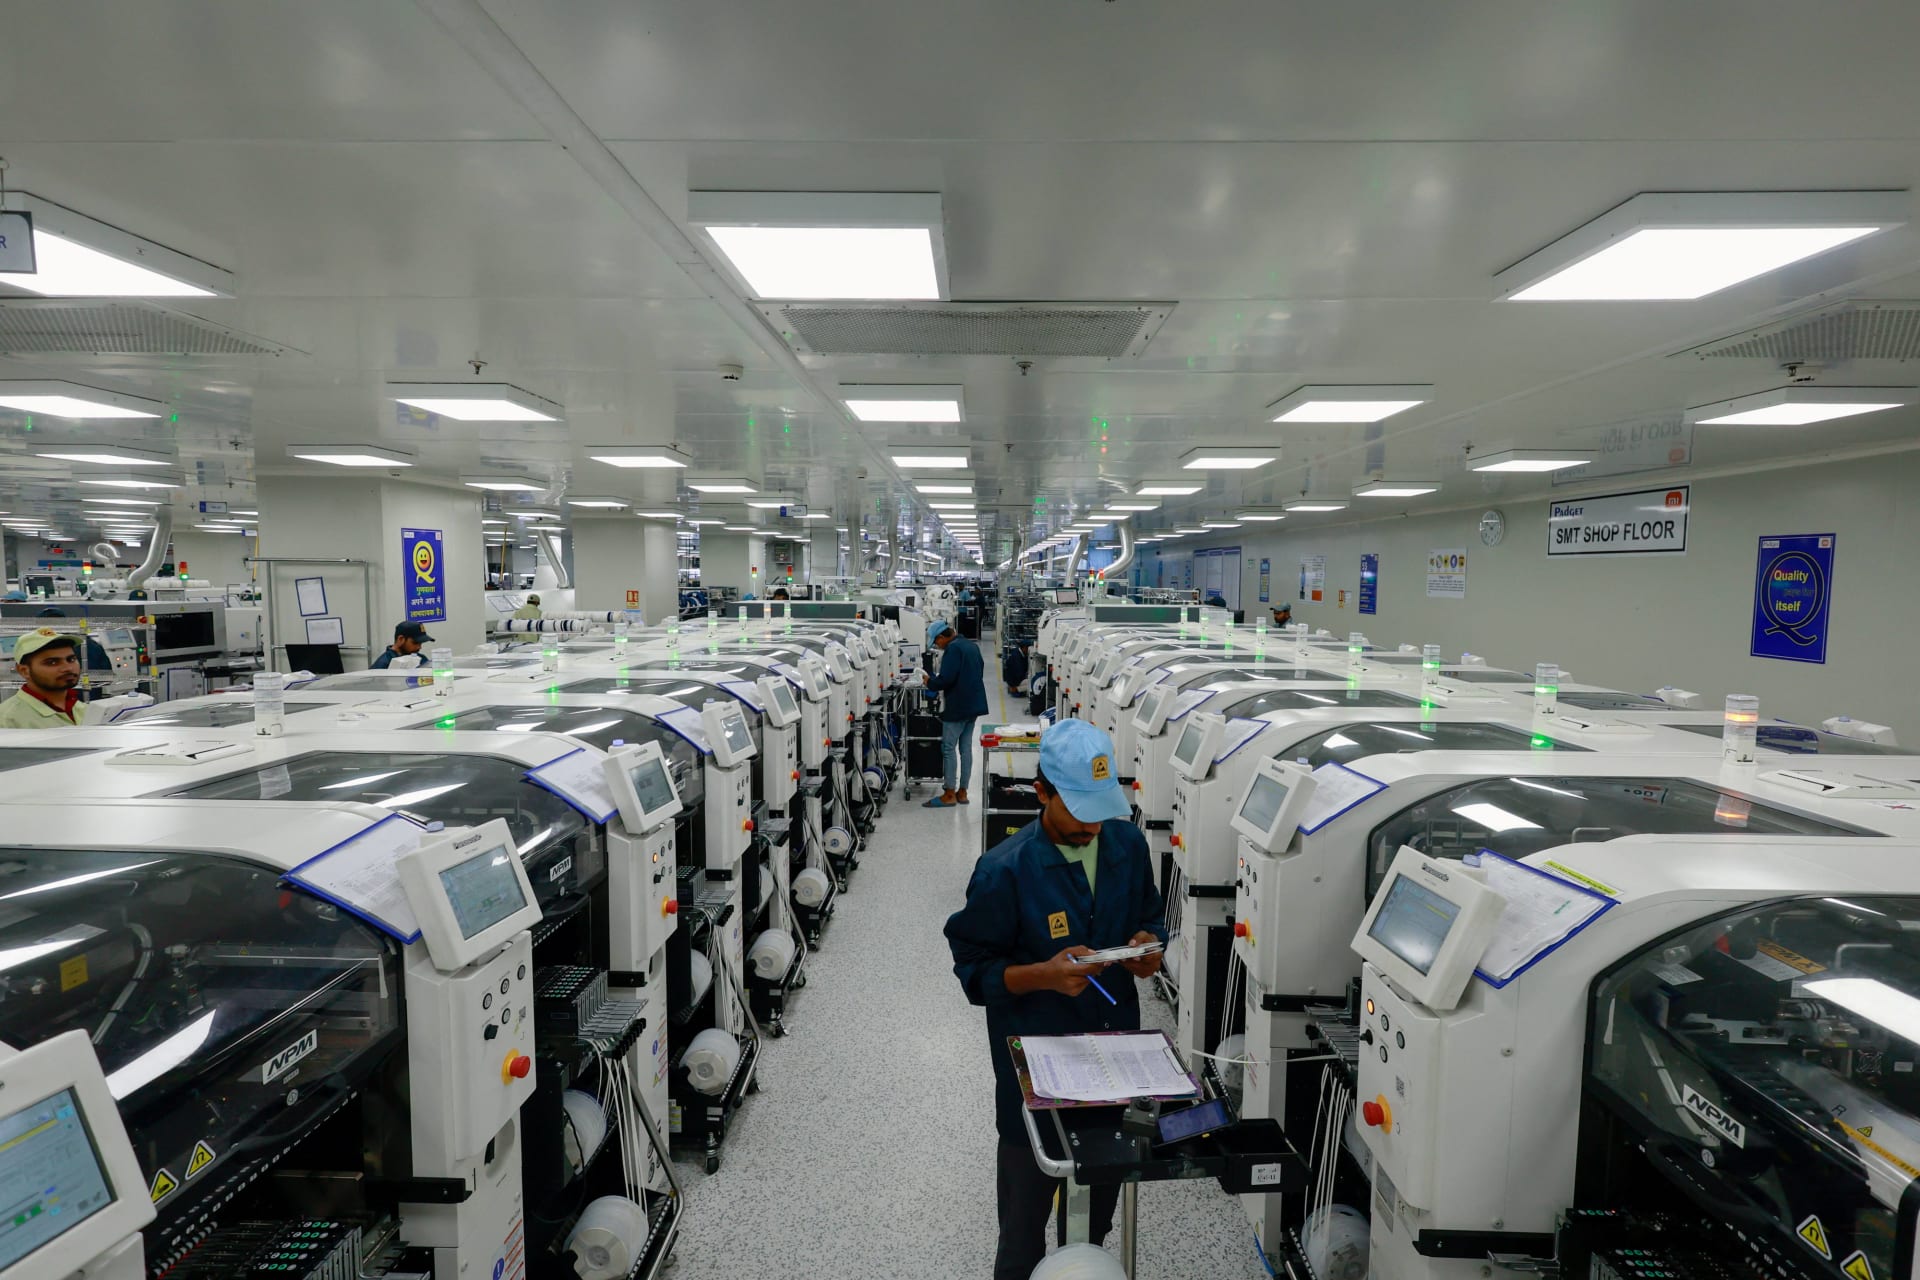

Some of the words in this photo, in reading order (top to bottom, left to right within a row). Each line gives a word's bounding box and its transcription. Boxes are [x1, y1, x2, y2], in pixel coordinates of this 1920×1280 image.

[1556, 527, 1581, 544] SMT
[1583, 524, 1620, 543] SHOP
[1623, 520, 1675, 541] FLOOR
[1774, 570, 1809, 584] Quality
[1776, 600, 1801, 611] itself
[551, 858, 570, 877] NPM
[267, 1033, 313, 1077] NPM
[1687, 1093, 1740, 1139] NPM
